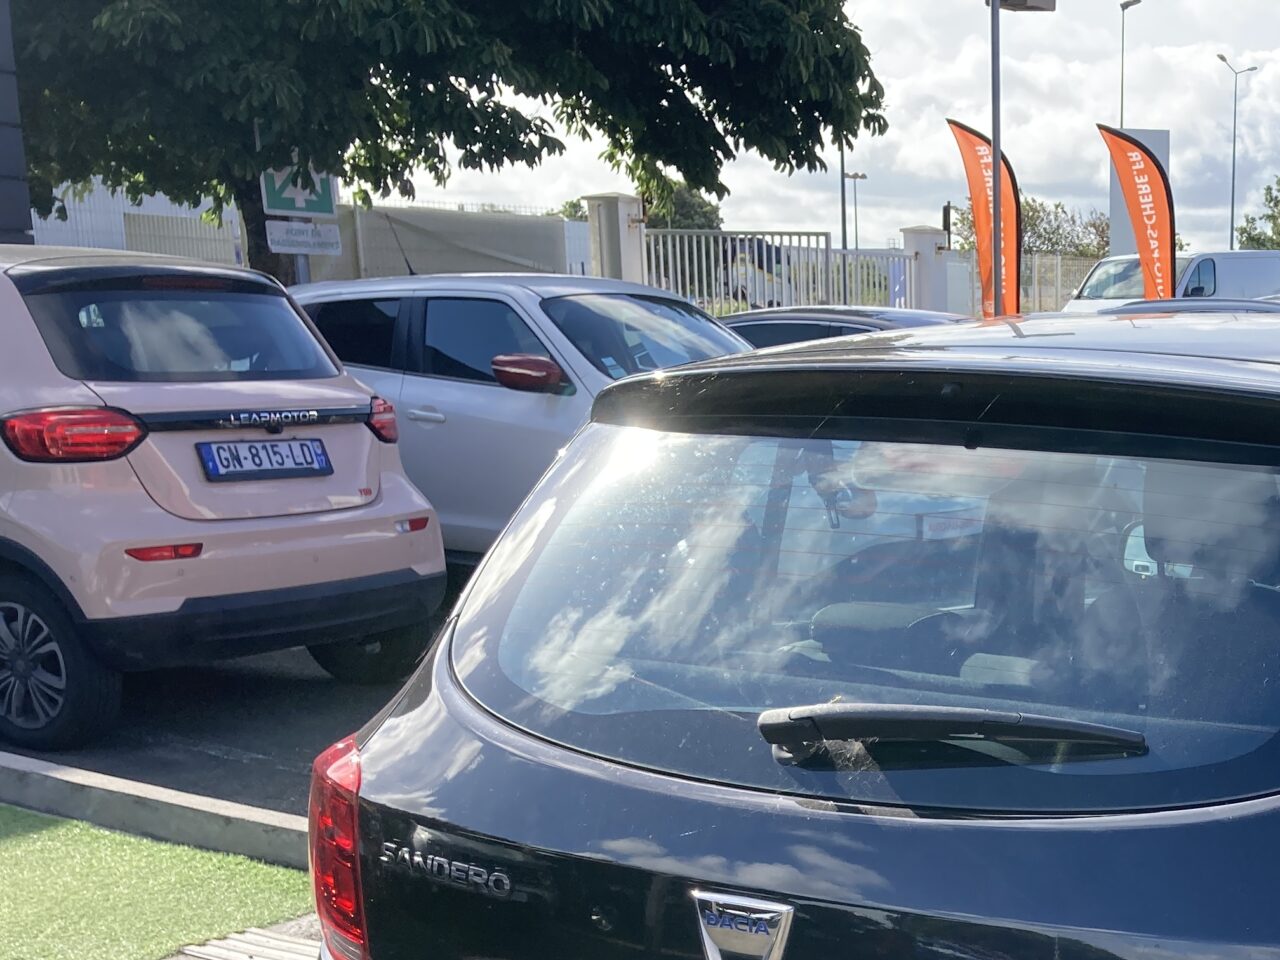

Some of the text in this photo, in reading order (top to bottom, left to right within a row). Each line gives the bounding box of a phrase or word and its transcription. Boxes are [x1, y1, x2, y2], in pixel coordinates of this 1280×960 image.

[230, 410, 318, 425] LEAPMOTOR
[216, 443, 315, 469] GN-815-LD
[379, 841, 511, 897] SANDERO
[705, 910, 769, 935] DACIA
